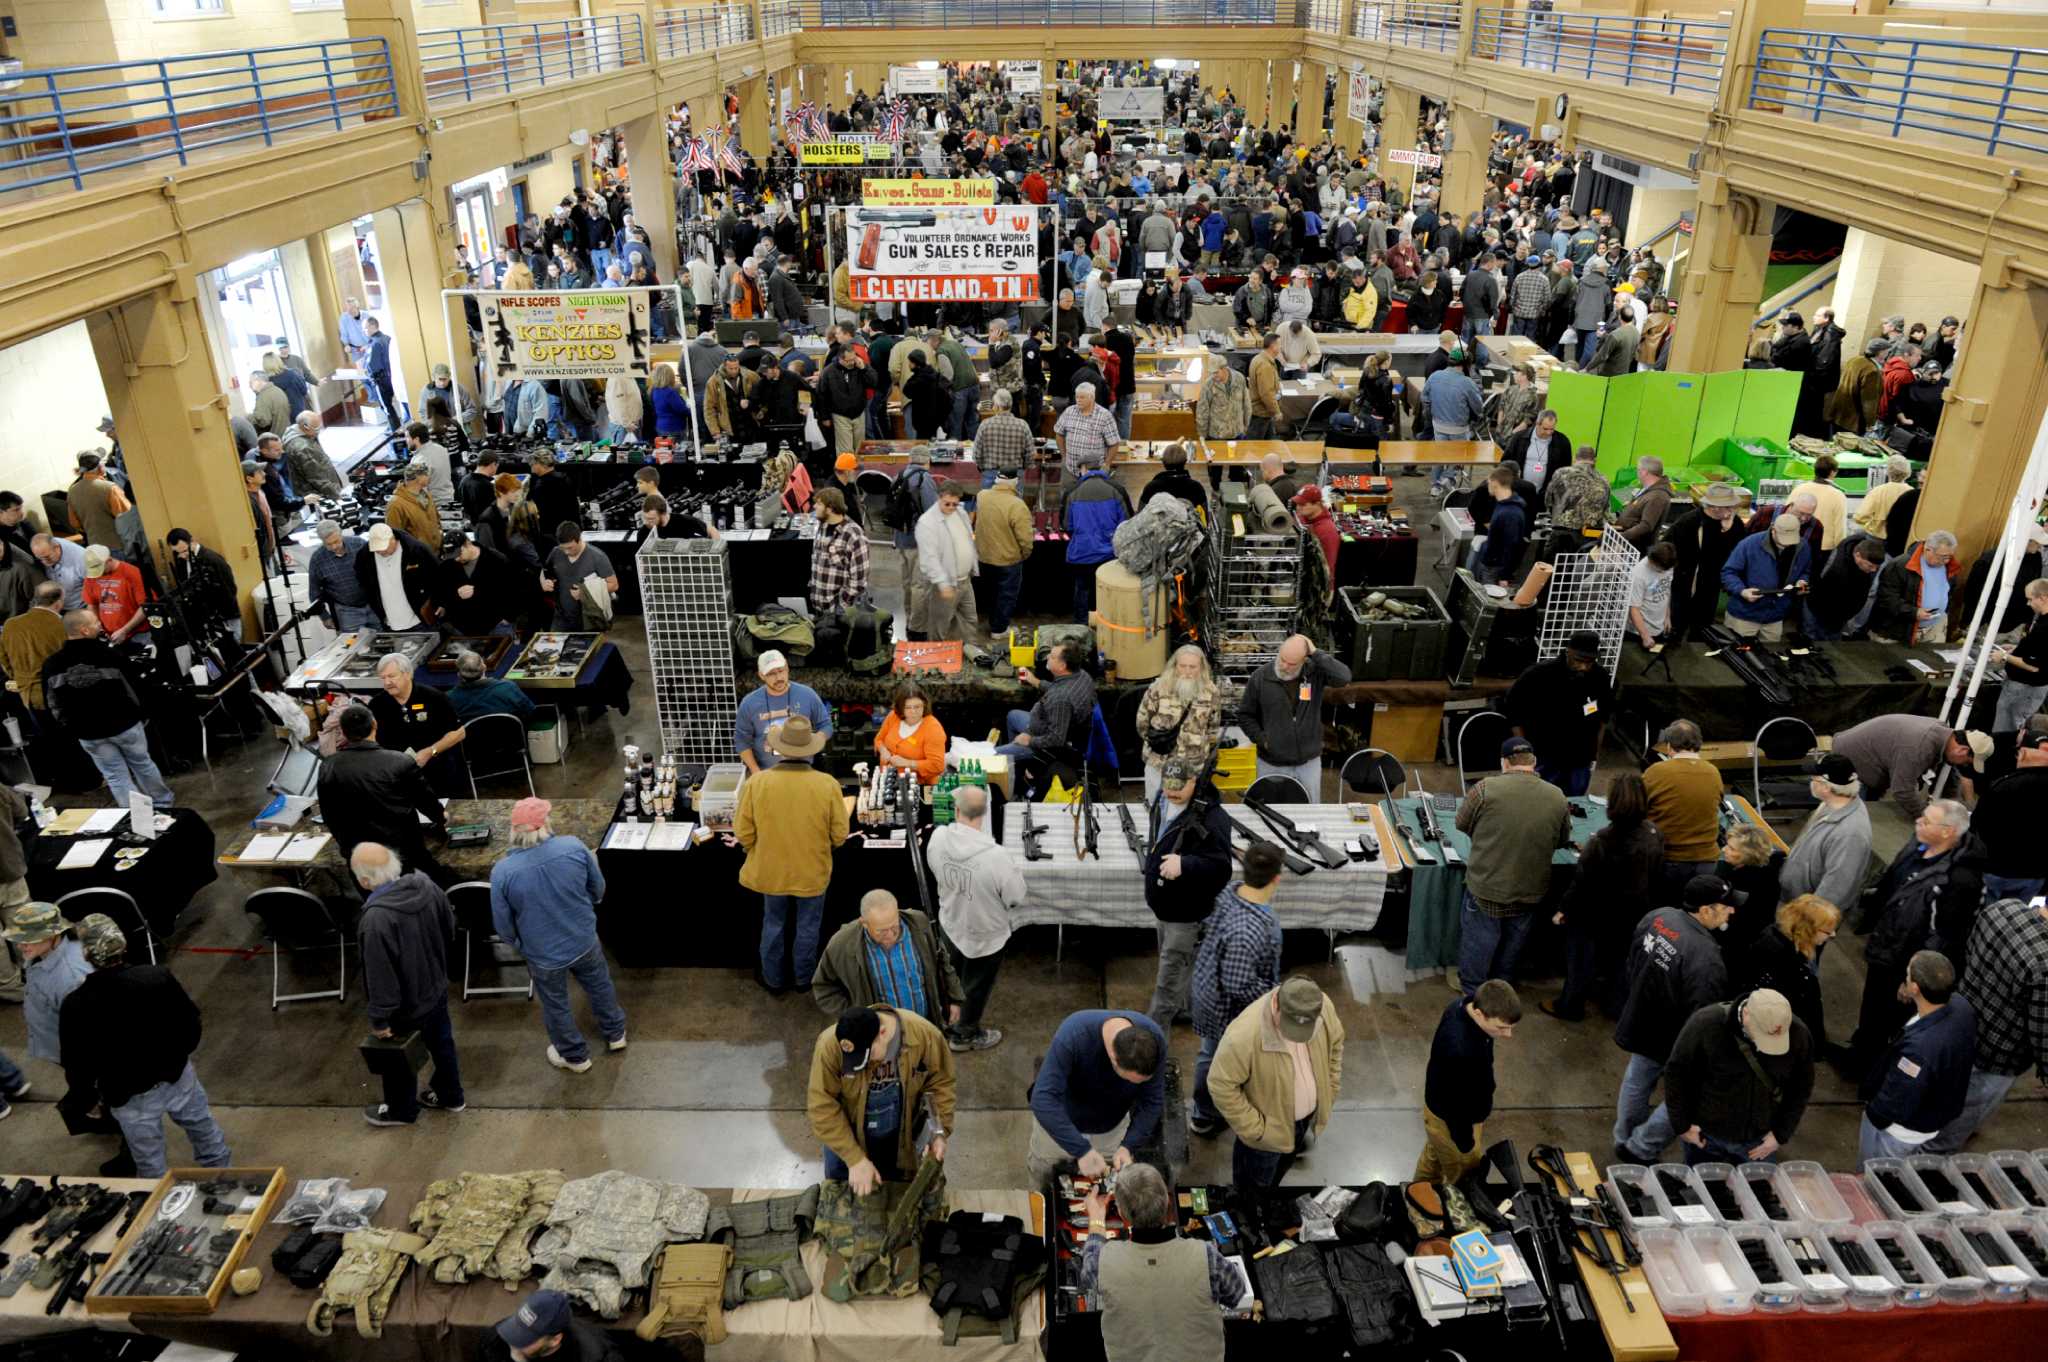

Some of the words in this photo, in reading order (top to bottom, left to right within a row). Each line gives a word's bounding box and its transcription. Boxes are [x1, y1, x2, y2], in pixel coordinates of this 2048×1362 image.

[804, 145, 860, 155] HOLSTERS
[1390, 151, 1416, 162] AMMO
[1418, 153, 1440, 166] CLIPS
[953, 181, 993, 198] Bullets
[903, 233, 951, 243] VOLUNTEER
[954, 233, 998, 243] ORDNANCE
[1001, 233, 1031, 242] WORKS
[889, 244, 918, 259] GUN
[925, 244, 969, 258] SALES
[973, 244, 982, 258] &
[985, 243, 1035, 258] REPAIR
[992, 276, 1022, 299] TN
[500, 297, 526, 308] RIFLE
[527, 296, 561, 307] SCOPES
[517, 324, 622, 342] KENZIES
[529, 344, 616, 364] OPTICS
